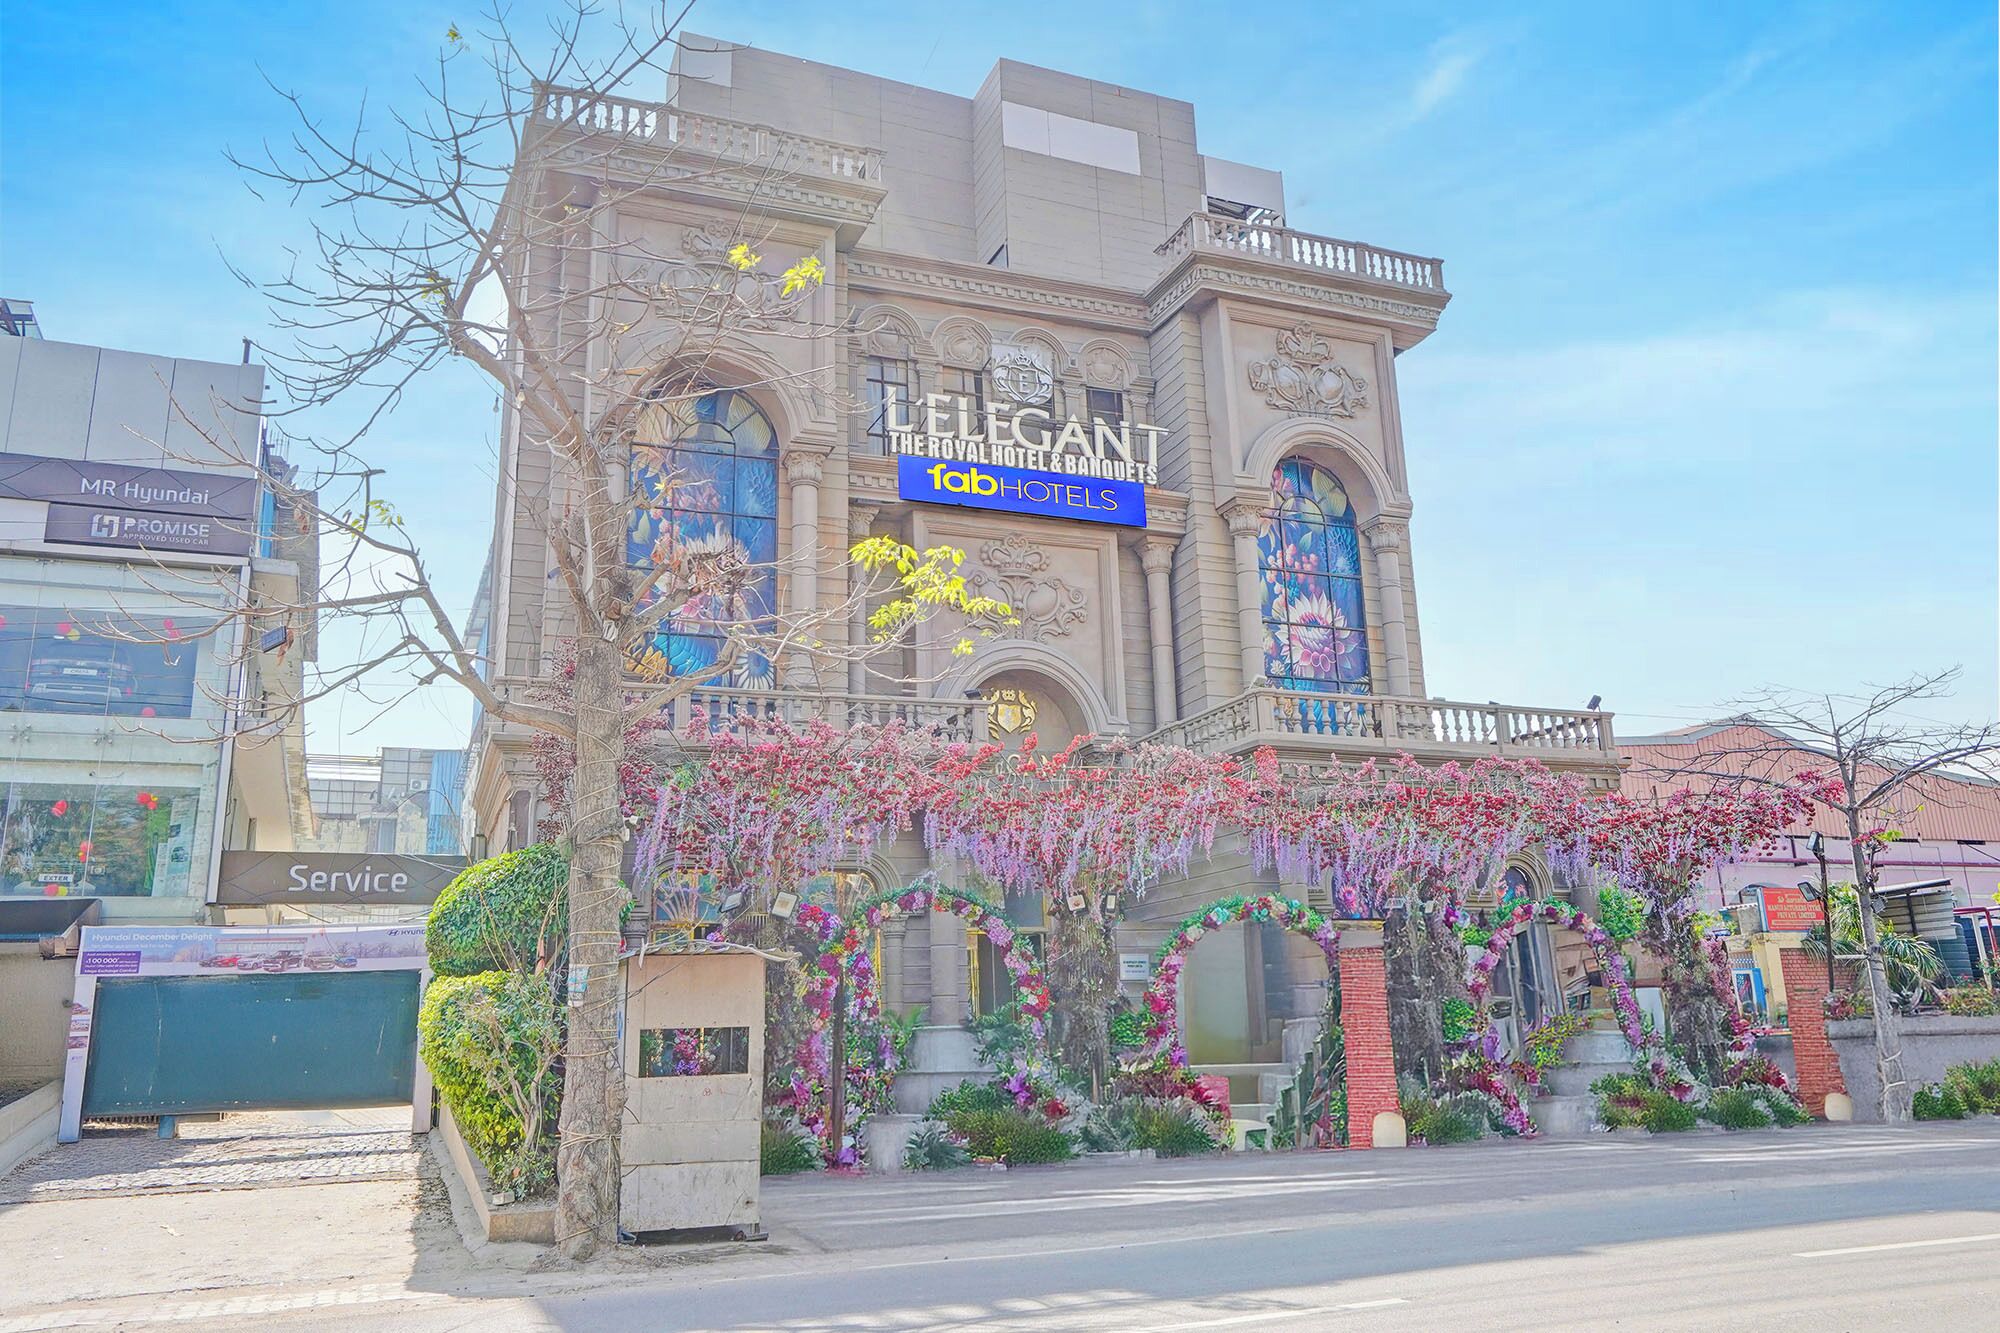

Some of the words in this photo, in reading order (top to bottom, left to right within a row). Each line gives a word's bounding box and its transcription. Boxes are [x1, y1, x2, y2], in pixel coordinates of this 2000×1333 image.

[889, 431, 924, 455] THE
[928, 436, 985, 464] ROYAL
[992, 444, 1048, 471] HOTEL
[1050, 452, 1062, 473] &
[1068, 455, 1158, 485] BANQUETS
[80, 478, 117, 496] MR
[124, 483, 209, 505] Hyundai
[124, 517, 210, 537] PROMISE
[123, 533, 167, 542] APPROVED
[170, 536, 191, 544] USED
[193, 537, 209, 545] CAR
[288, 865, 409, 893] Service
[92, 933, 131, 941] Hyundai
[133, 932, 180, 940] December
[181, 932, 213, 941] Delight
